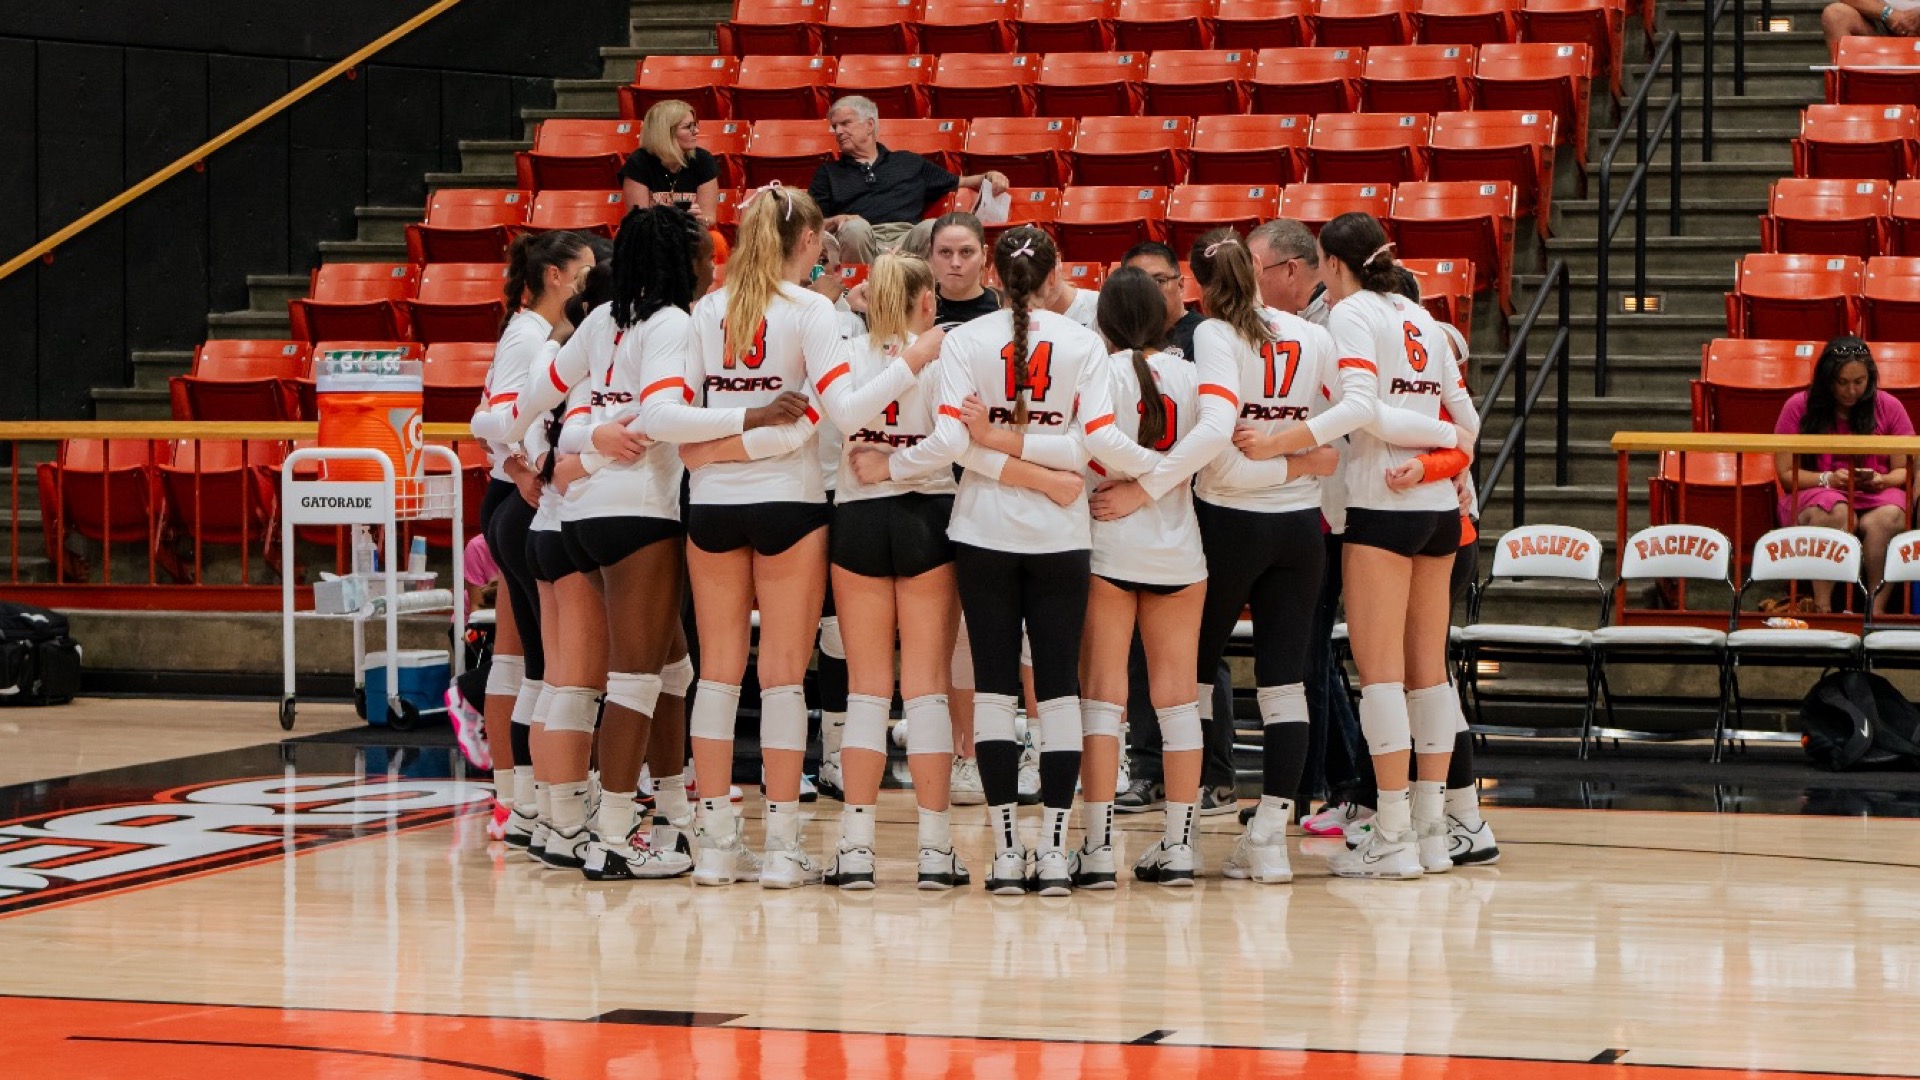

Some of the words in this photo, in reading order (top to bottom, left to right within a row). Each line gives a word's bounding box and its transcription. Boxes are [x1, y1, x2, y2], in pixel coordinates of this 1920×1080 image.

[1403, 320, 1429, 373] 6
[1000, 340, 1054, 402] 14
[1259, 339, 1302, 398] 17
[705, 374, 783, 391] PACIFIC
[1390, 377, 1441, 396] PACIFIC
[1240, 402, 1309, 421] PACIFIC
[301, 496, 372, 509] GATORADE
[1505, 534, 1591, 561] PACIFIC
[1634, 534, 1721, 561] PACIFIC
[1764, 536, 1851, 564] PACIFIC
